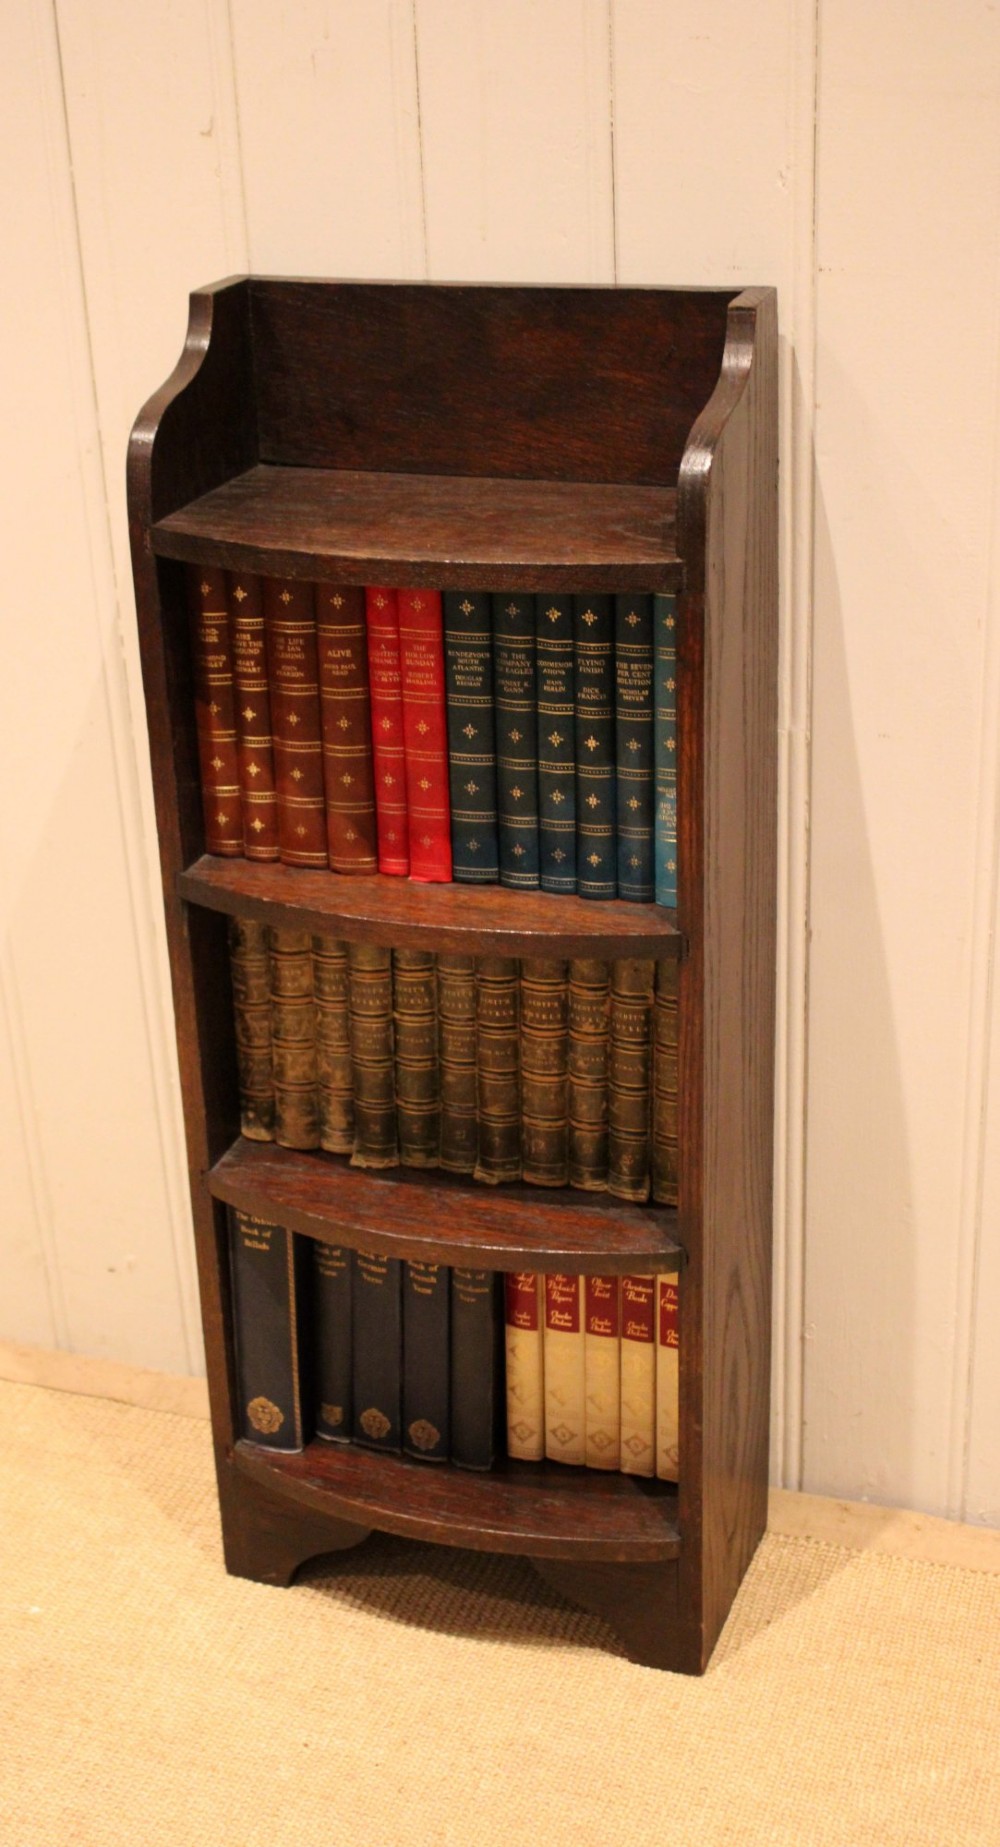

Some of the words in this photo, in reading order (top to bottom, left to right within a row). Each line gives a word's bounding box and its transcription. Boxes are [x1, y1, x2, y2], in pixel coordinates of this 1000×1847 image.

[288, 638, 304, 646] LIFE
[413, 644, 426, 652] THE
[328, 650, 352, 658] ALIVE
[406, 652, 434, 660] HOLLOW
[448, 650, 490, 658] RENDEZVOUS
[512, 652, 526, 660] THE
[406, 659, 434, 667] SUNDAY
[578, 658, 605, 666] FLYING
[616, 662, 628, 670] THE
[452, 664, 485, 672] ATLANTIC
[580, 666, 604, 674] FINISH
[455, 674, 483, 682] DOUGLAS
[617, 677, 652, 686] SOLUTION
[236, 1211, 249, 1220] The
[240, 1225, 259, 1236] Book
[262, 1230, 272, 1238] of
[244, 1239, 270, 1250] Ballads
[358, 1260, 388, 1274] German
[428, 1264, 440, 1272] of
[362, 1272, 384, 1285] Verse
[410, 1270, 437, 1284] French
[476, 1272, 486, 1280] of
[548, 1280, 576, 1292] Pickwick
[592, 1278, 612, 1288] Oliver
[622, 1280, 654, 1294] Christmas
[412, 1283, 432, 1294] Verse
[592, 1288, 610, 1298] Twist
[551, 1291, 572, 1304] Papers
[626, 1290, 648, 1304] Books
[551, 1310, 572, 1320] Charles
[550, 1316, 572, 1327] Dickens
[590, 1316, 612, 1326] Charles
[590, 1324, 612, 1334] Dickens
[627, 1321, 648, 1332] Charles
[626, 1329, 648, 1338] Dickens
